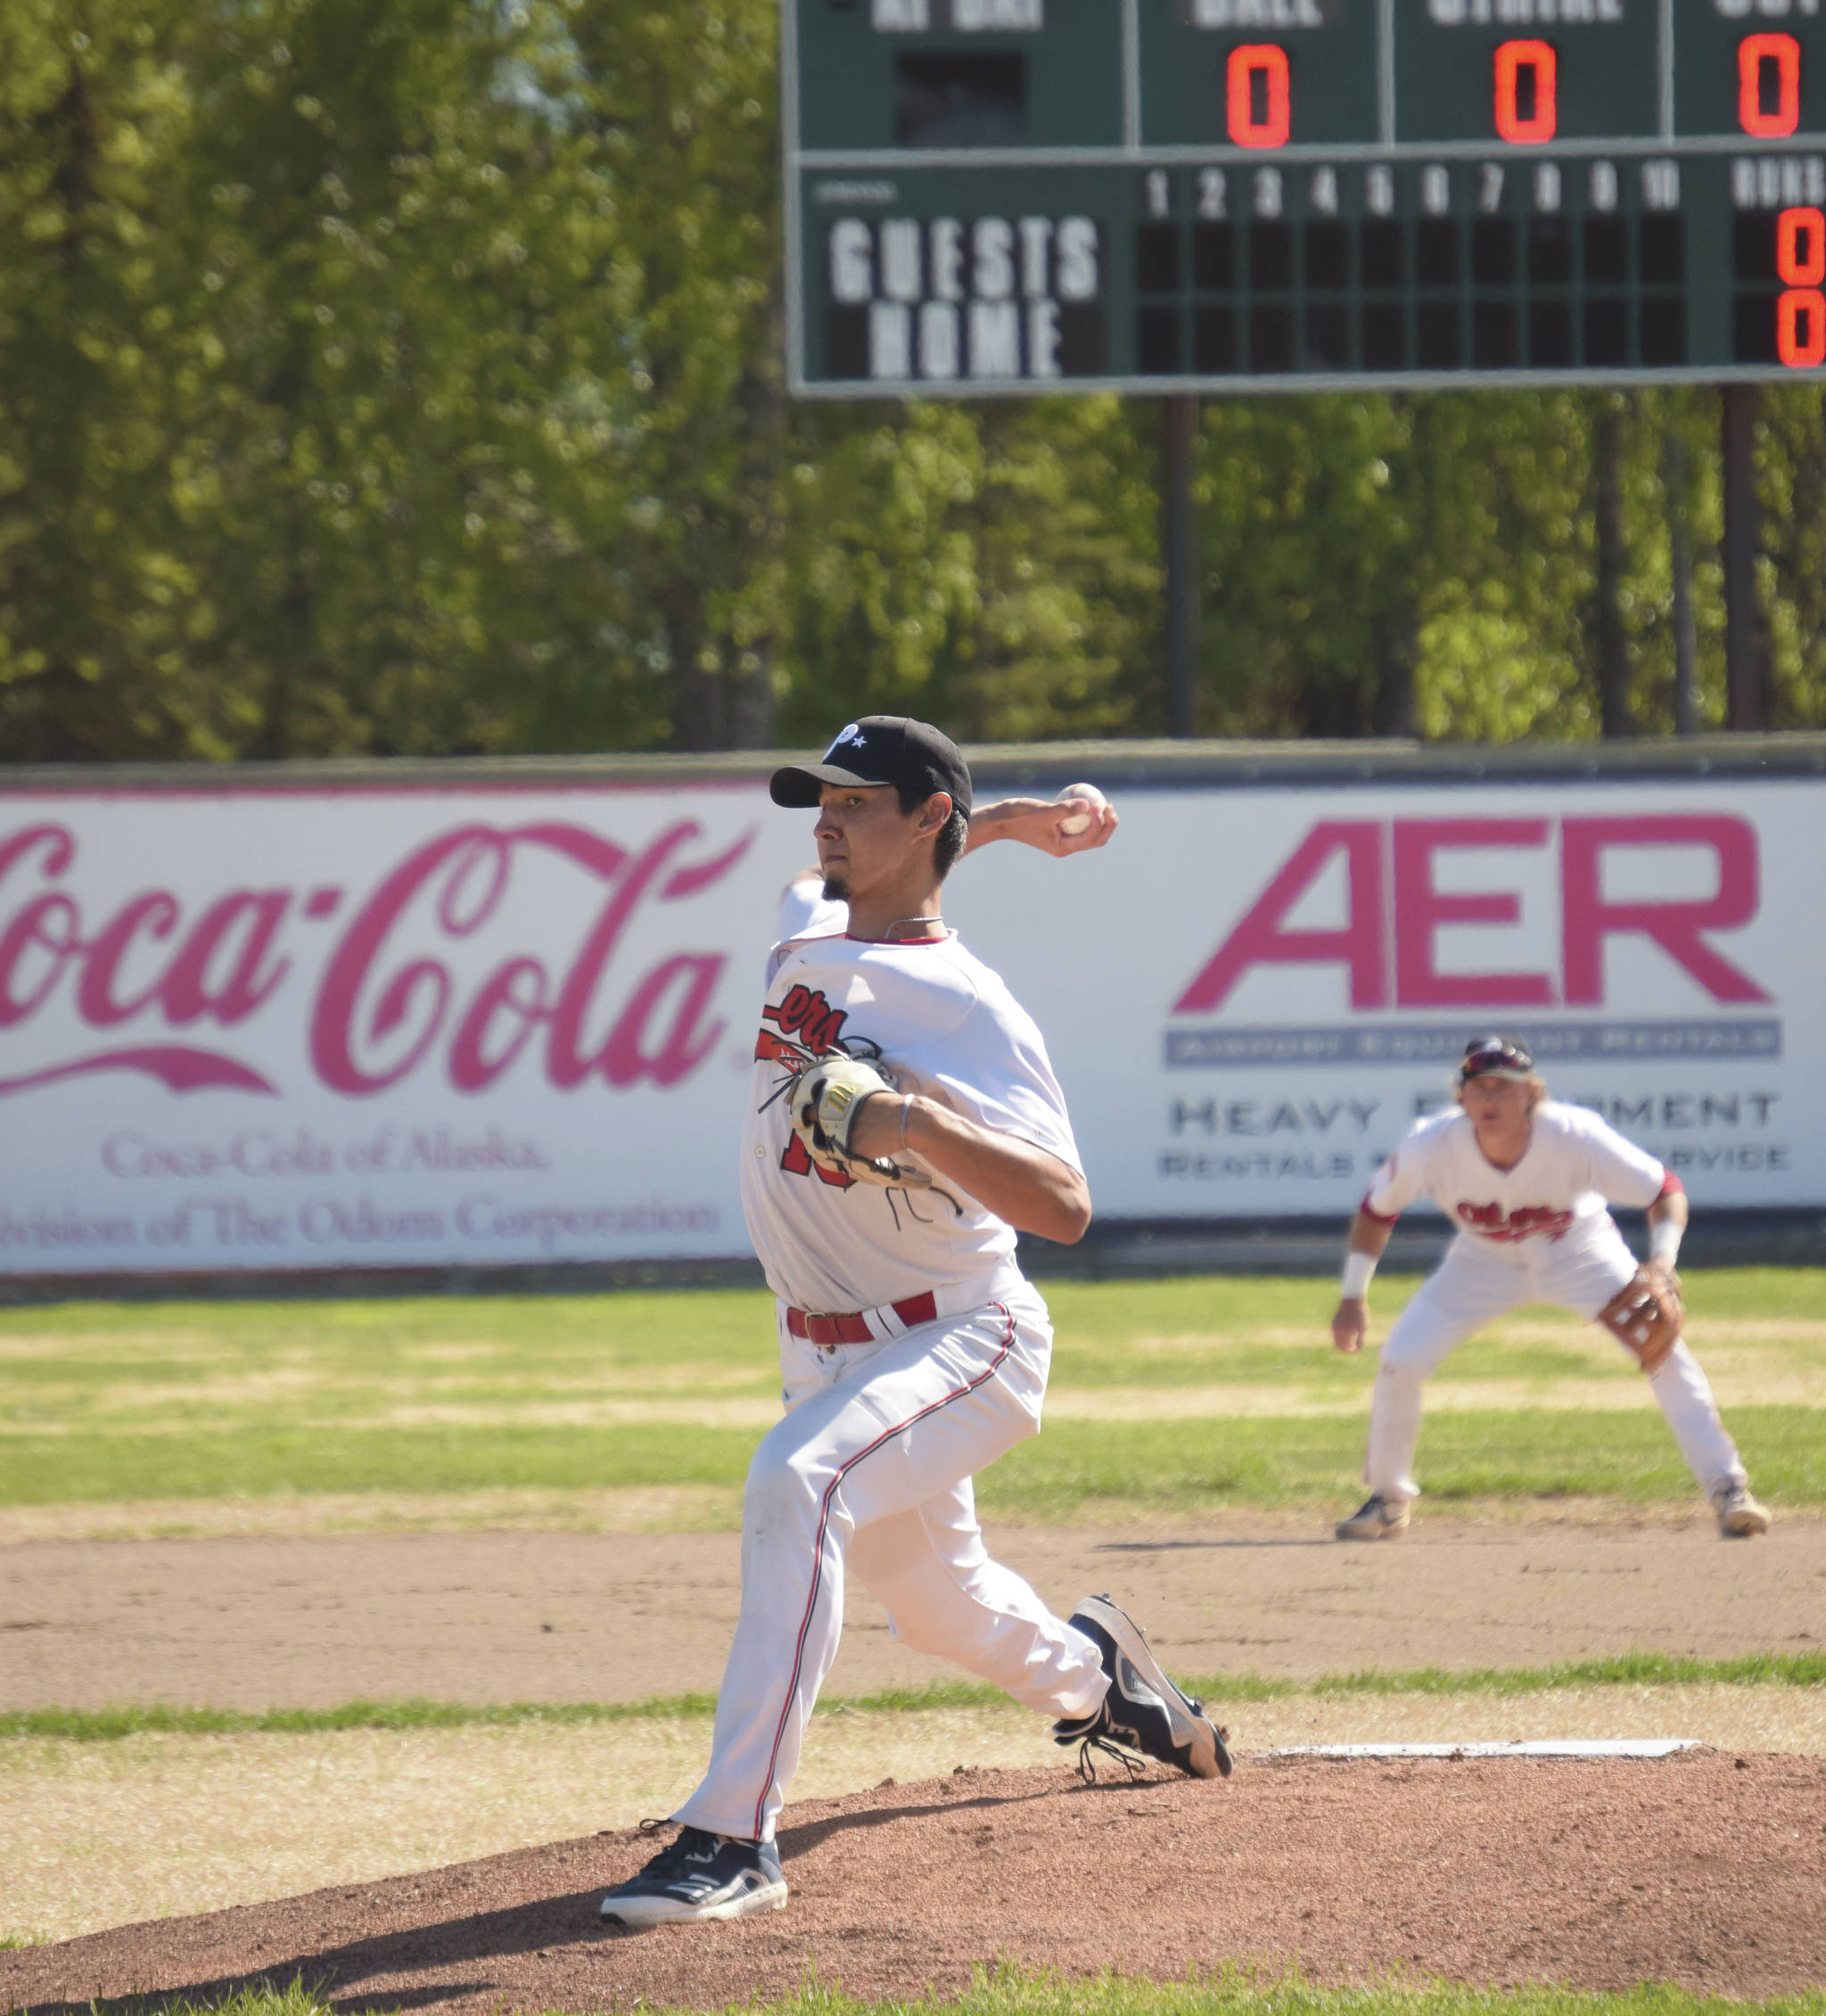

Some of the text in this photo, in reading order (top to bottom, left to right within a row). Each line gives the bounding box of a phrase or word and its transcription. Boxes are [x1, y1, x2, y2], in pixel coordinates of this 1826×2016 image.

[1227, 44, 1289, 148] 0
[1494, 39, 1556, 144] 0
[1738, 33, 1799, 138] 0
[1147, 169, 1169, 218] 1
[1199, 166, 1227, 219] 2
[829, 215, 1099, 304] GUESTS
[1778, 207, 1825, 286] 0
[868, 297, 1063, 380] HOME
[1778, 289, 1825, 368] 0
[1170, 813, 1777, 1013] AER
[100, 1130, 335, 1180] Coca-Cola
[1171, 1098, 1381, 1135] HEAVY
[1160, 1153, 1354, 1180] RENTALS
[454, 1193, 720, 1248] Corporation
